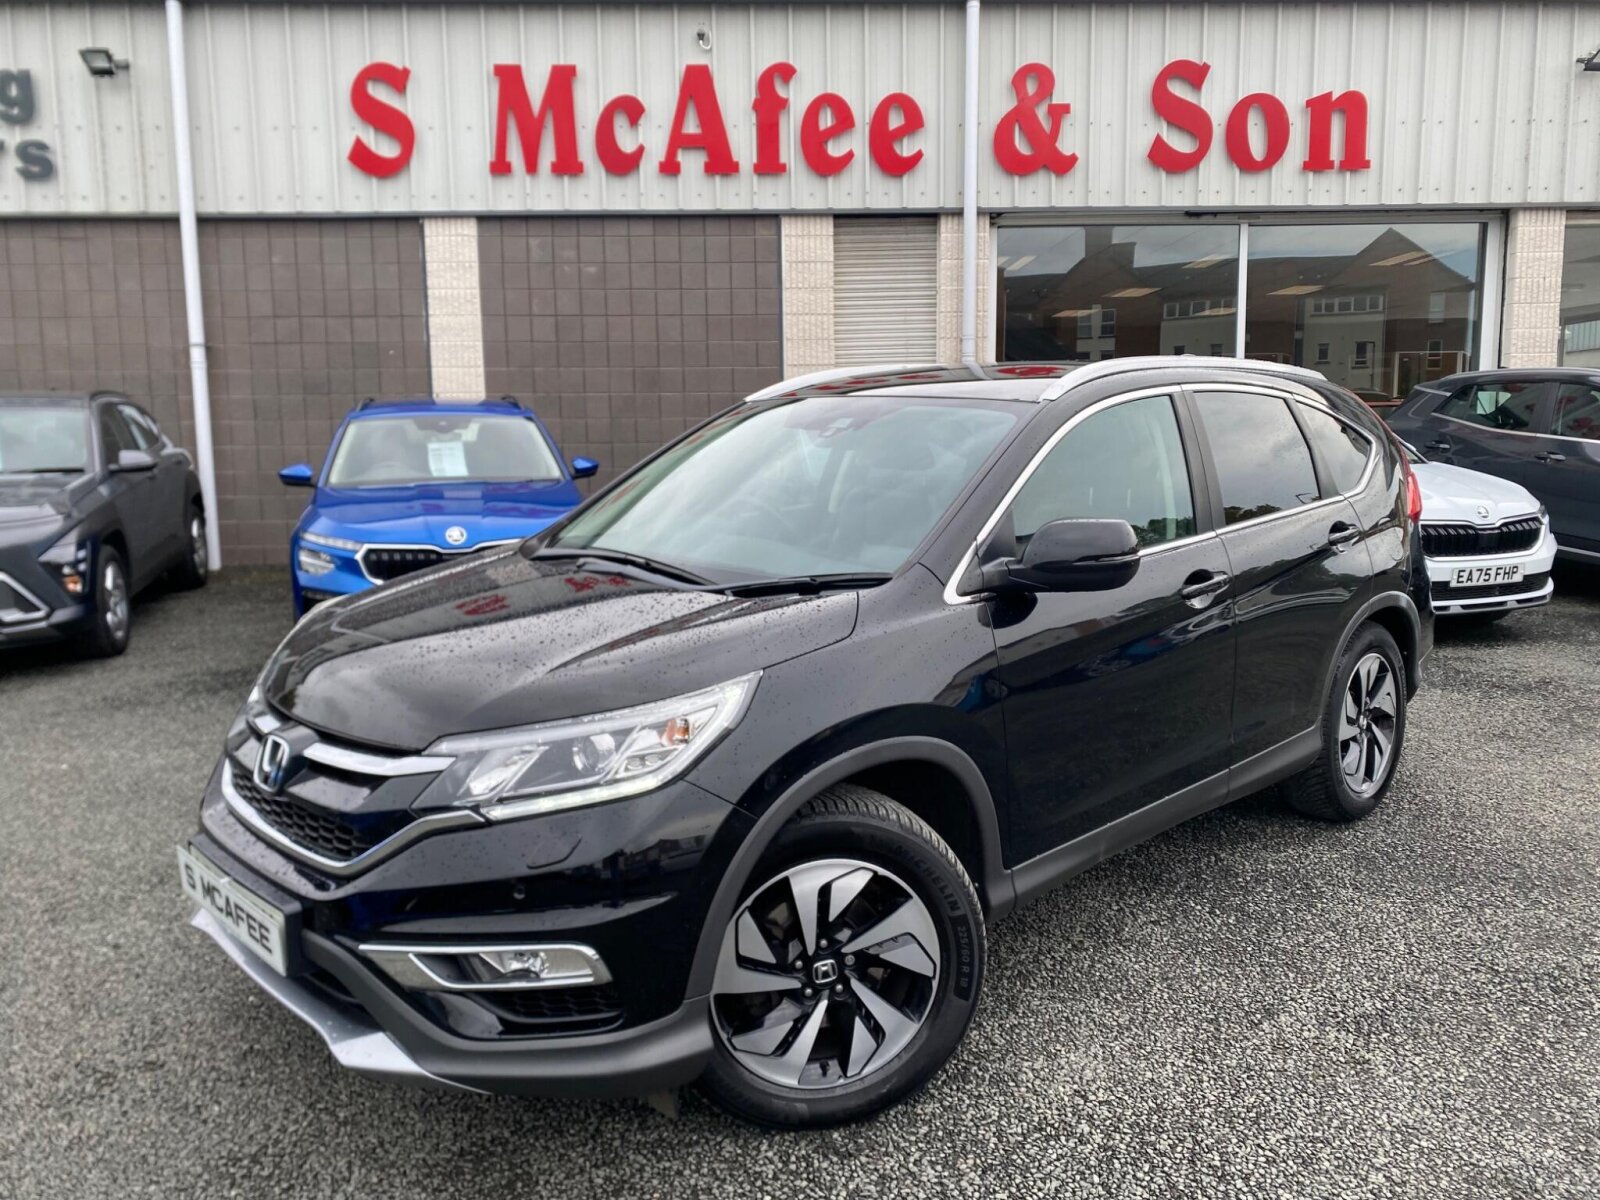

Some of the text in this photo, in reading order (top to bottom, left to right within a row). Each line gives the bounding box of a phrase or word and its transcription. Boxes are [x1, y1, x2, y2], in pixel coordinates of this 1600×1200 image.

[348, 59, 1372, 179] S McAfee & Son
[1457, 566, 1519, 584] EA75 FHP
[185, 864, 272, 954] S MCAFEE
[896, 846, 961, 912] MICHELIN
